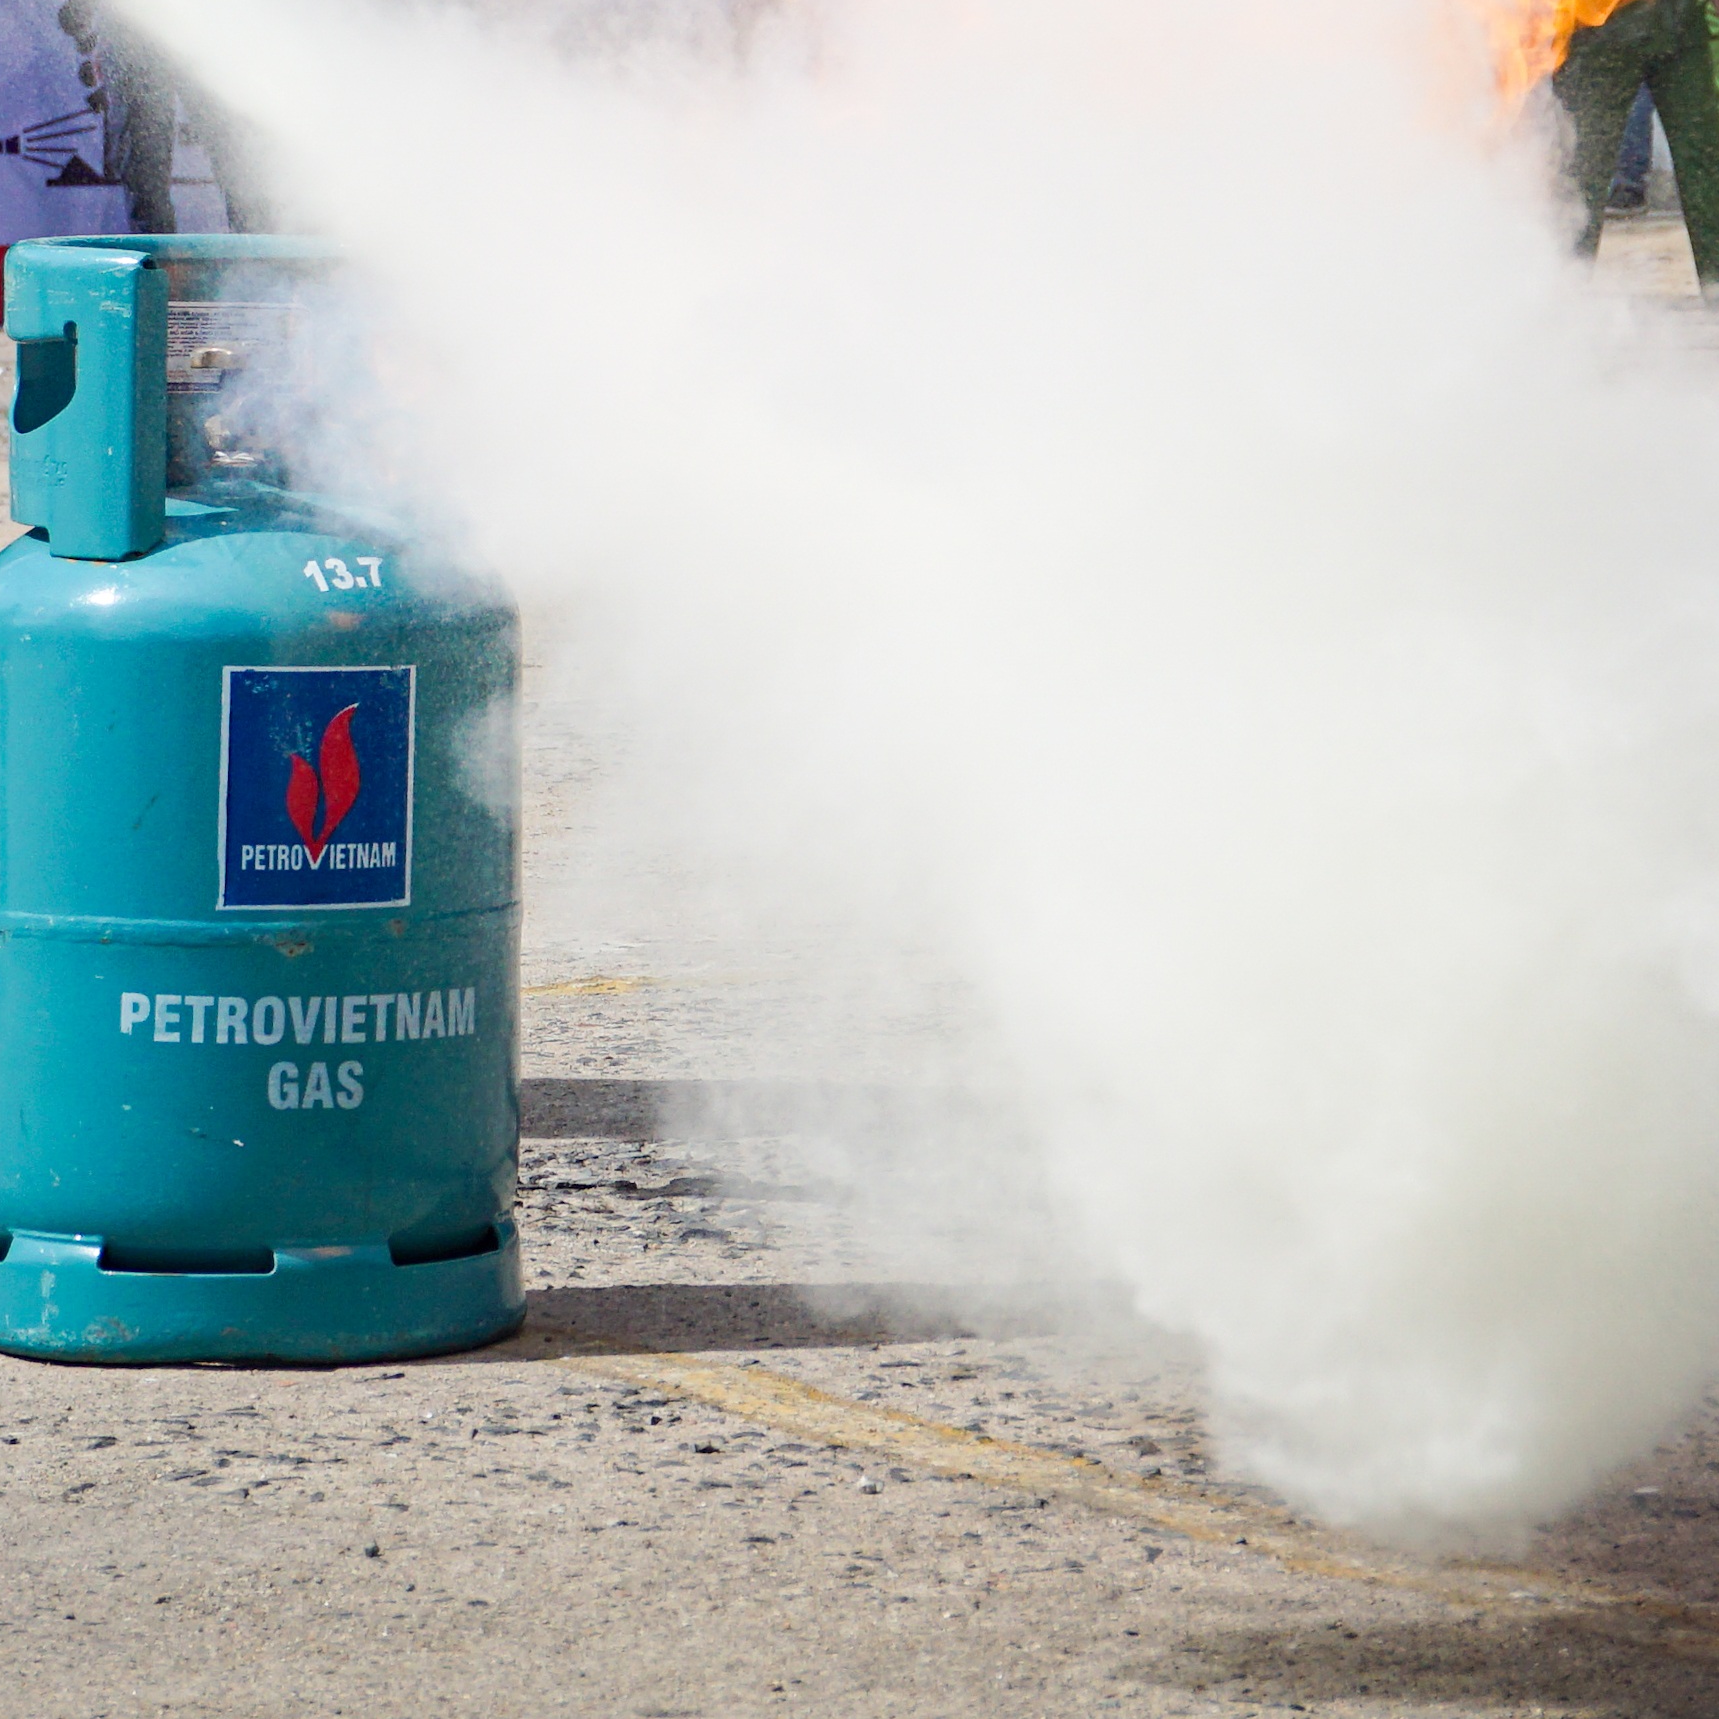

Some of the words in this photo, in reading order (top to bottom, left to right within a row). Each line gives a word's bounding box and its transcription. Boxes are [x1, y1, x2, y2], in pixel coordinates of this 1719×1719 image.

[303, 556, 383, 592] 13.7
[241, 841, 397, 871] PETROVIETNAM
[120, 986, 477, 1046] PETROVIETNAM
[267, 1060, 365, 1111] GAS
